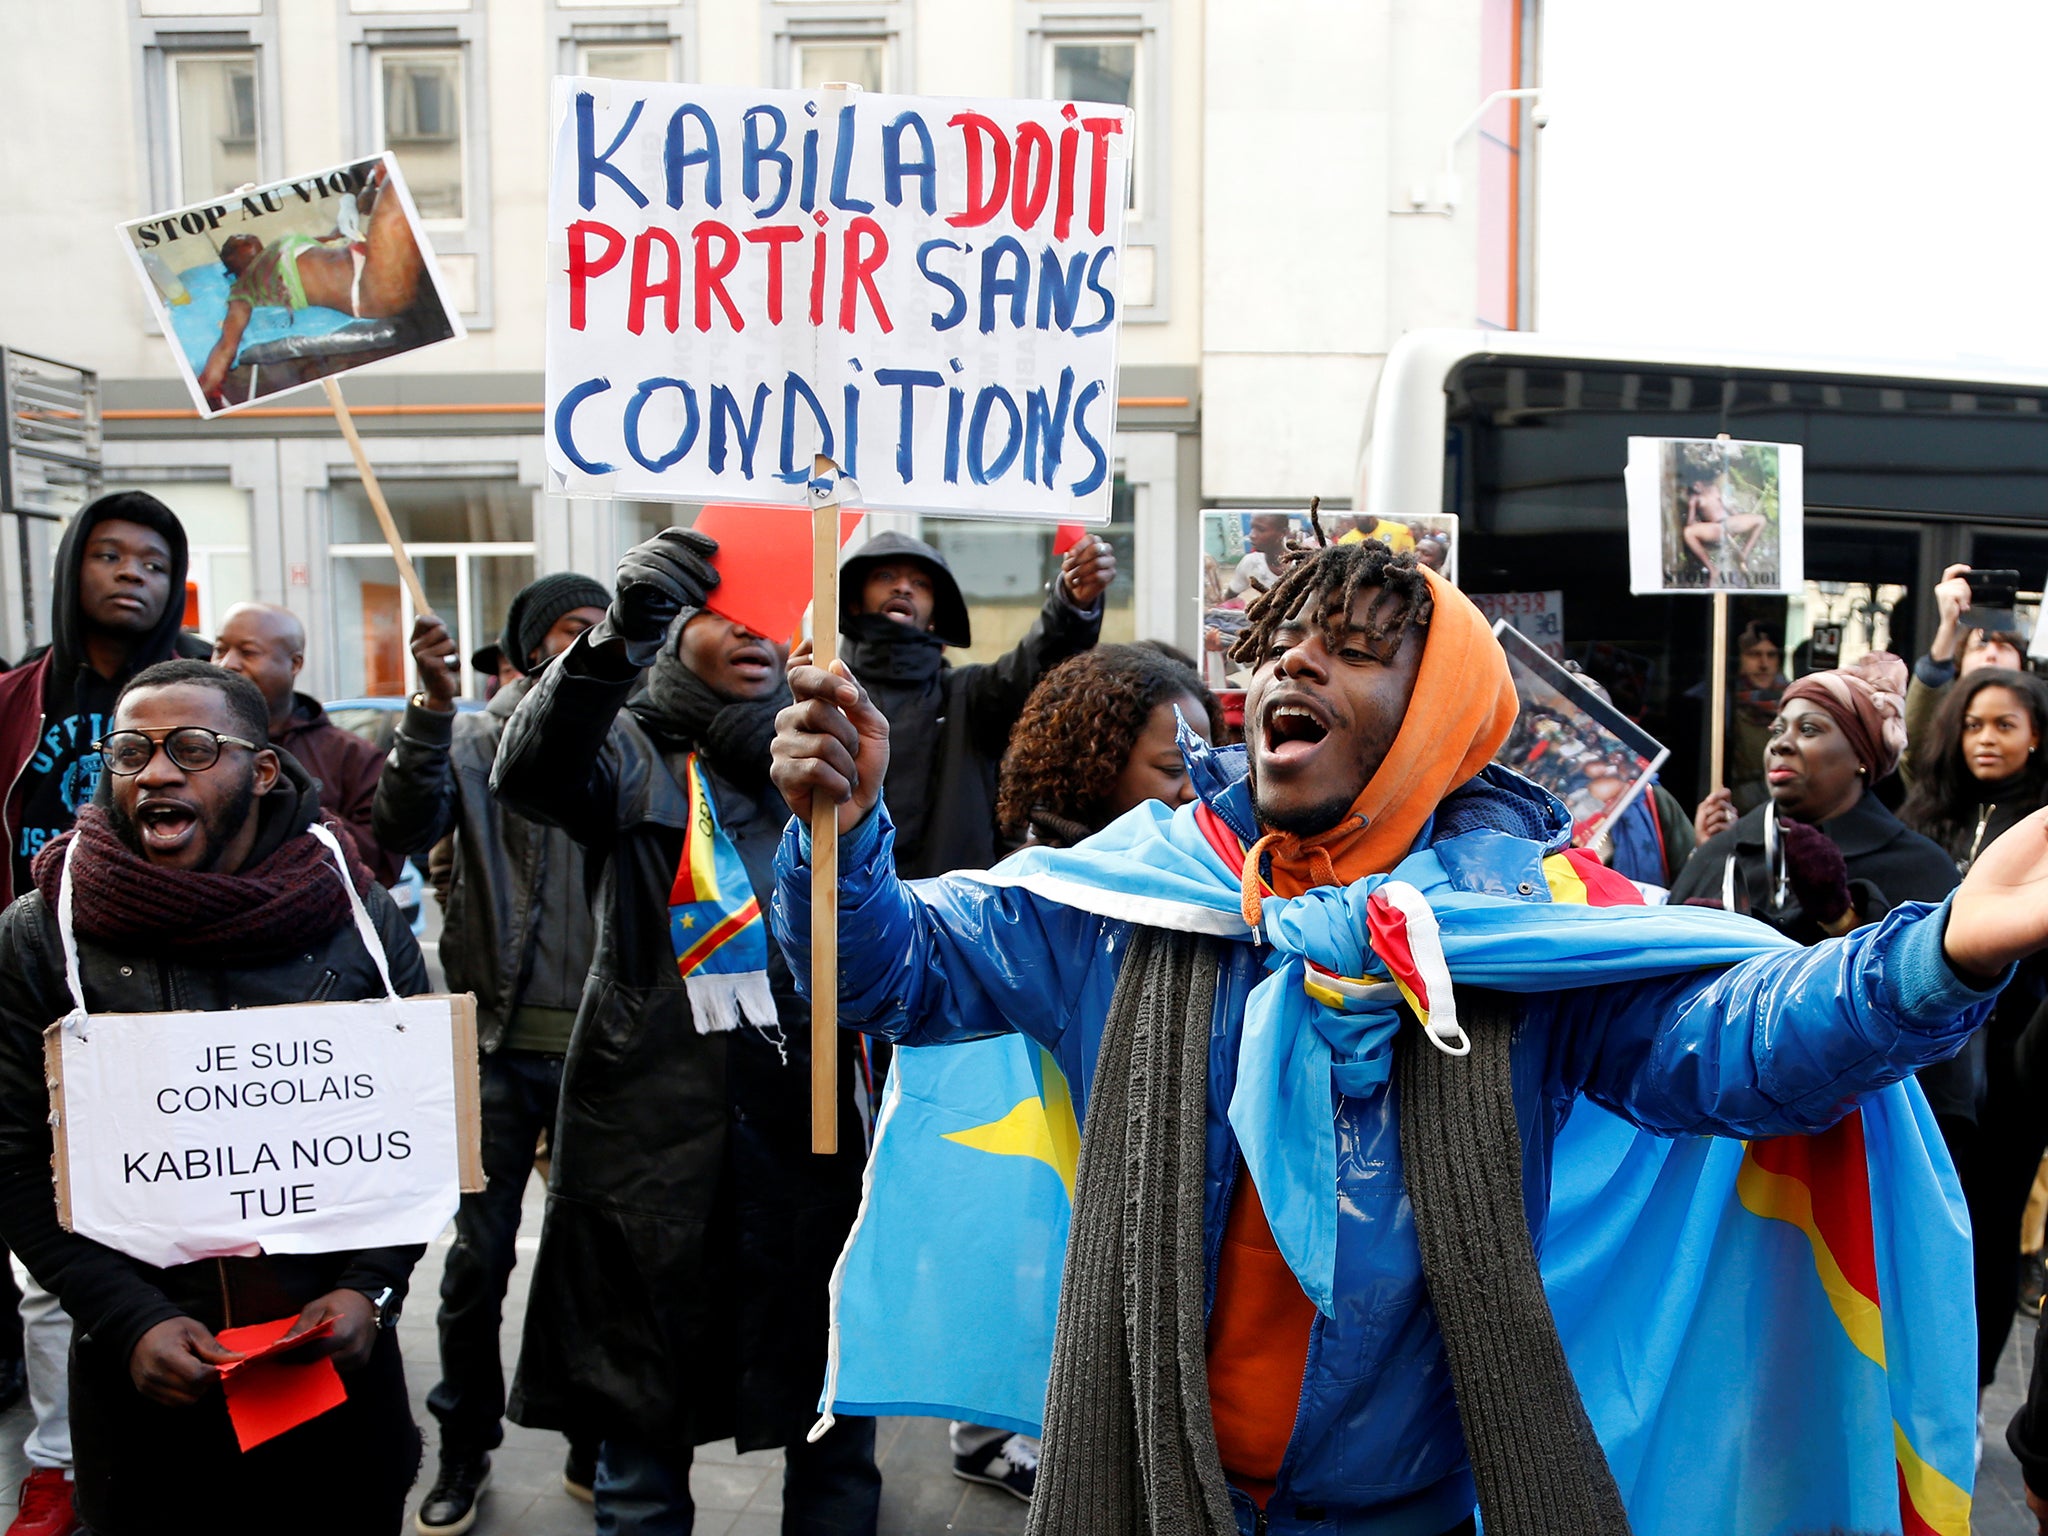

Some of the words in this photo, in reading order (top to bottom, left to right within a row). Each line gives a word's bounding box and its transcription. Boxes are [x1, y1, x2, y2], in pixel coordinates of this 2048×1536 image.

[137, 204, 226, 249] STOP
[241, 189, 285, 222] AU
[196, 1046, 238, 1073] JE
[251, 1039, 334, 1069] SUIS
[156, 1074, 374, 1114] CONGOLAIS
[123, 1143, 281, 1184] KABILA
[292, 1130, 412, 1169] NOUS
[230, 1183, 317, 1220] TUE
